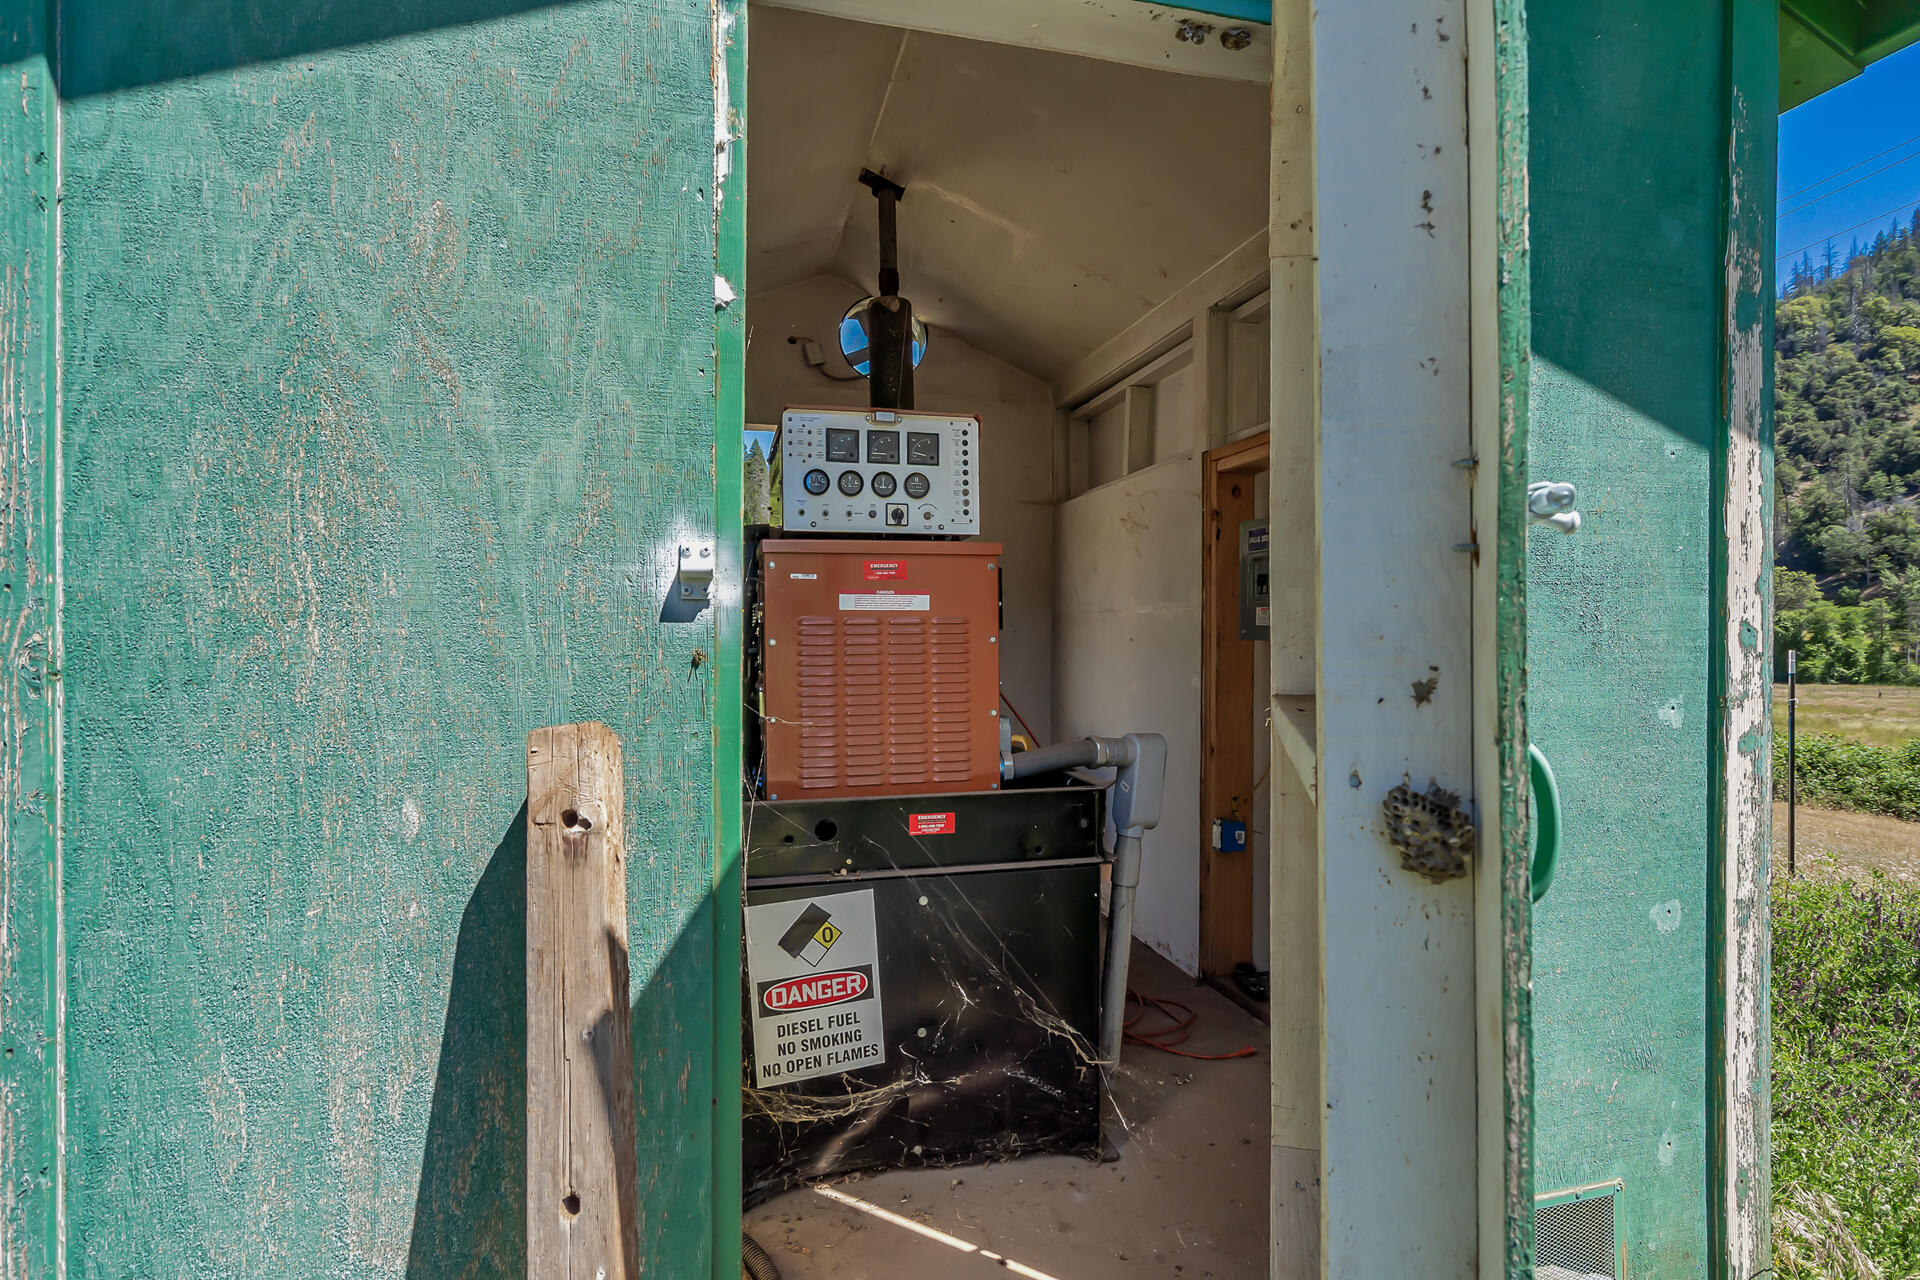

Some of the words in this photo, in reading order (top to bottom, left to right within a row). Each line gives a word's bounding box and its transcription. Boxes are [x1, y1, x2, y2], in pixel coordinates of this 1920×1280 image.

[821, 926, 834, 944] 0
[771, 975, 861, 1007] DANGER
[777, 1018, 824, 1038] DIESEL
[828, 1011, 861, 1029] FUEL
[777, 1041, 796, 1057] NO
[800, 1029, 862, 1053] SMOKING
[762, 1062, 781, 1078] NO
[786, 1055, 822, 1074] OPEN
[826, 1043, 879, 1066] FLAMES
